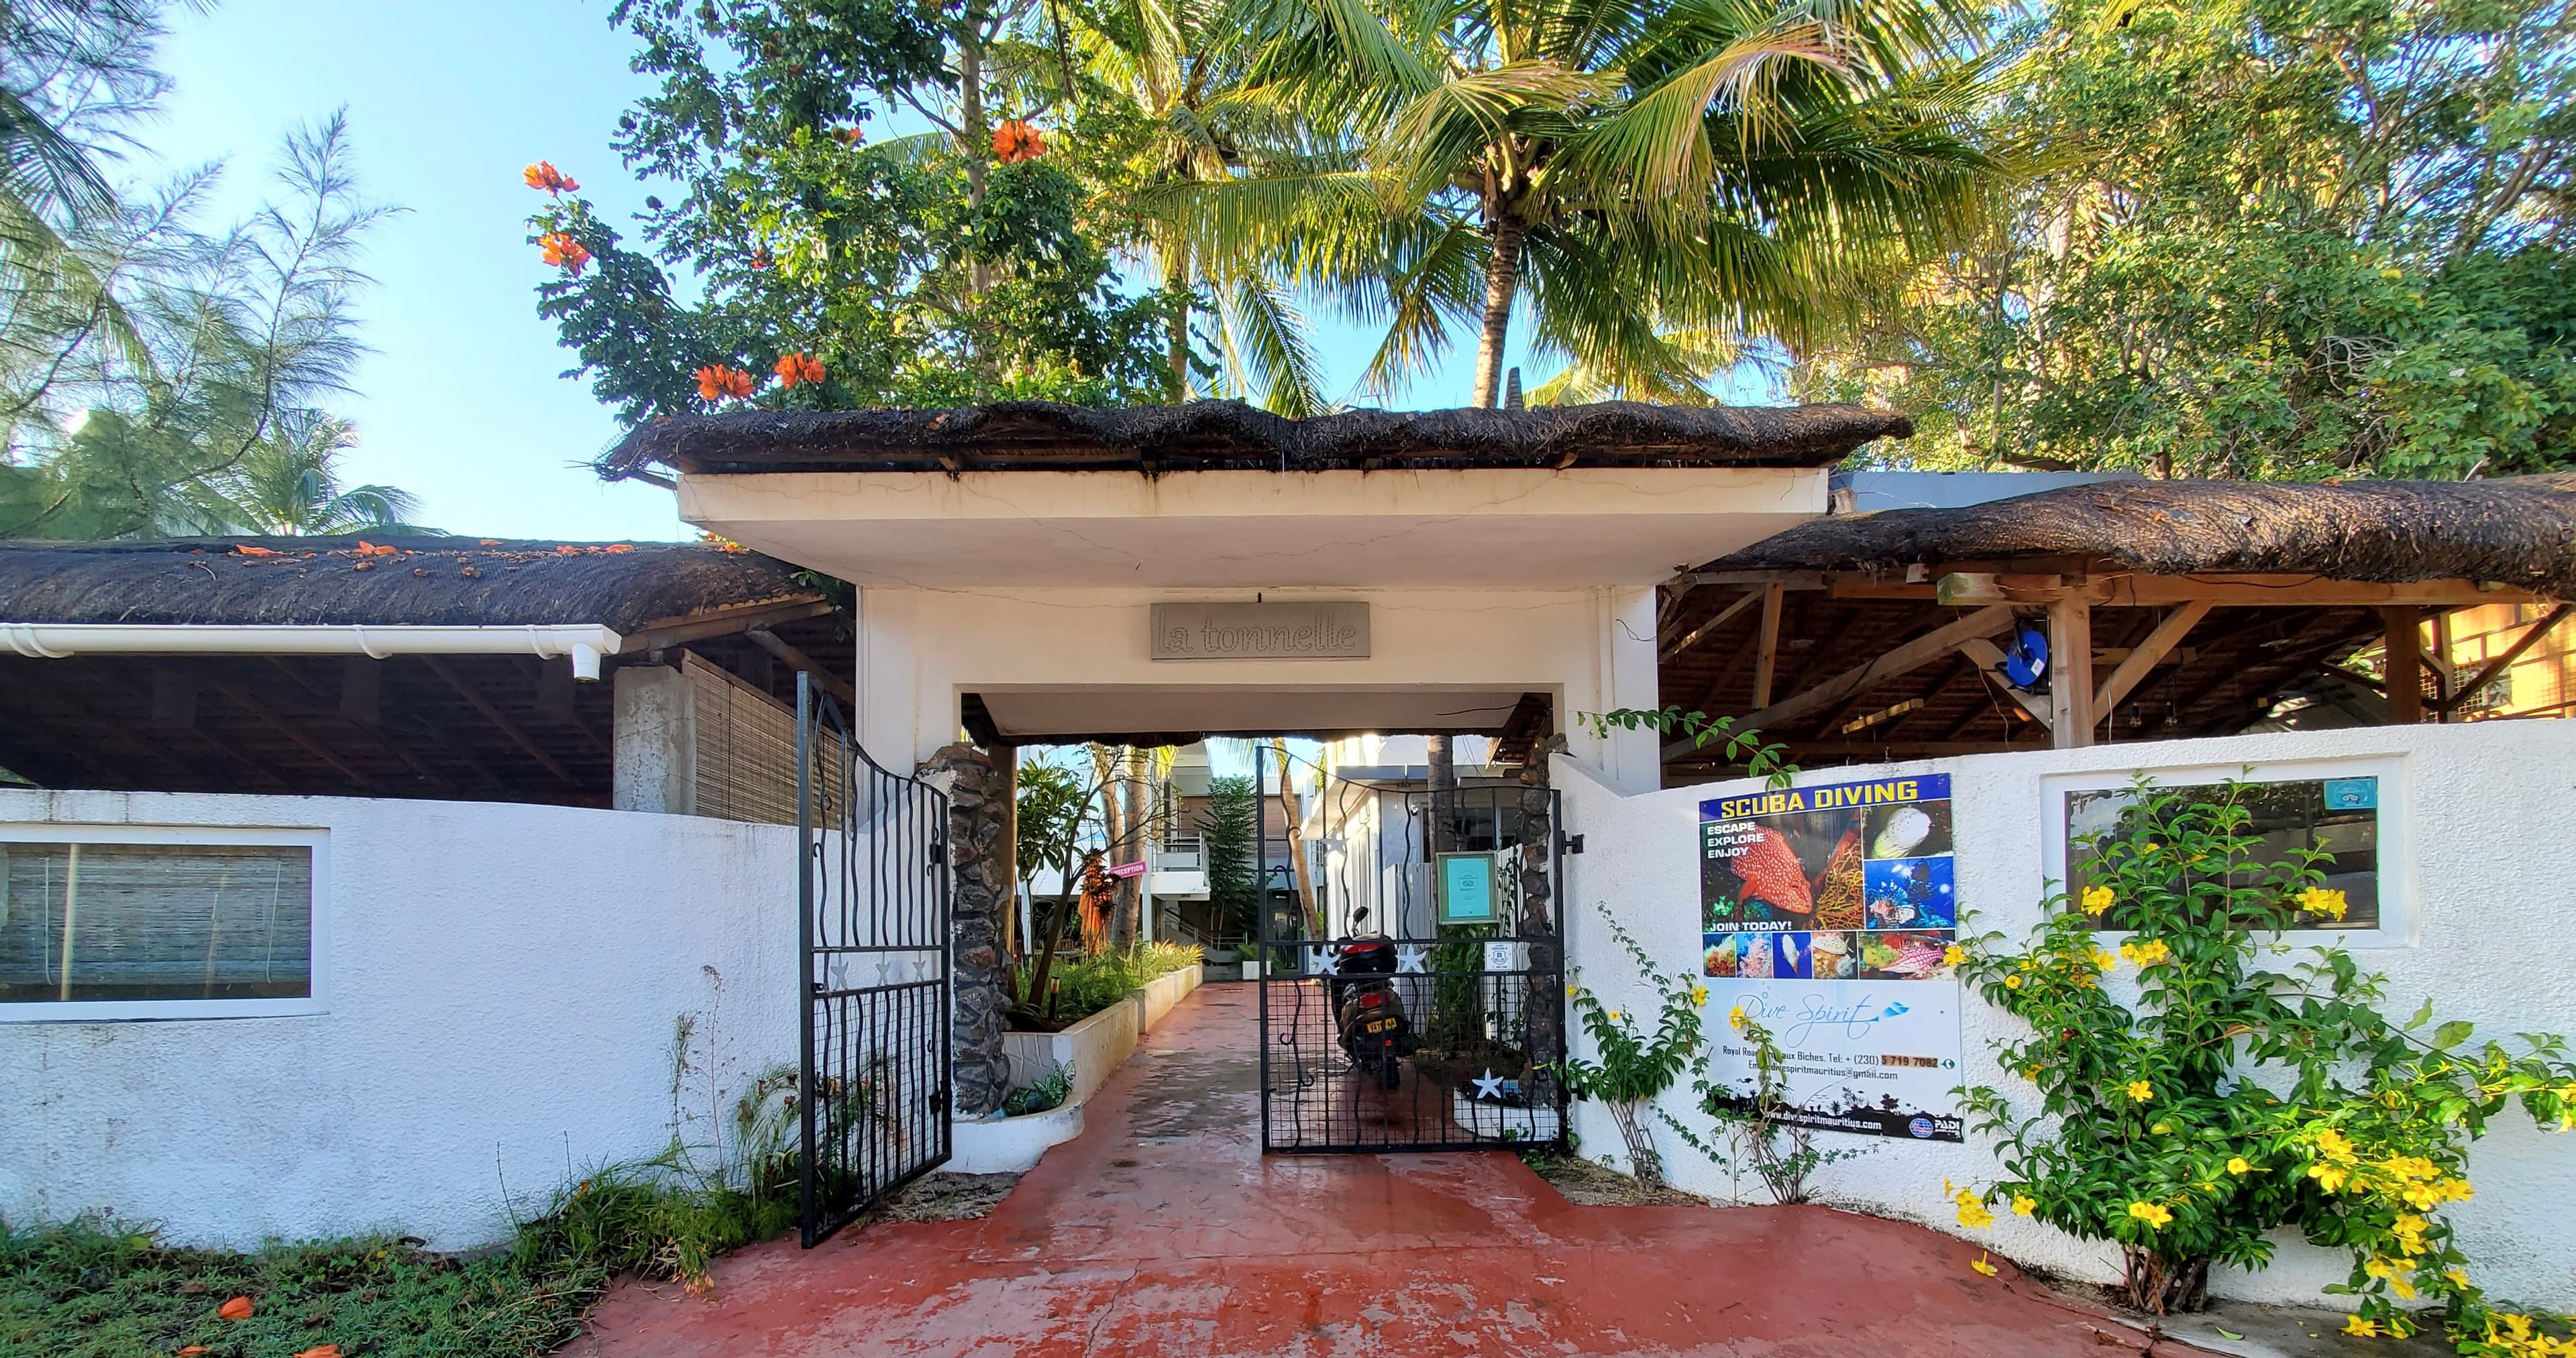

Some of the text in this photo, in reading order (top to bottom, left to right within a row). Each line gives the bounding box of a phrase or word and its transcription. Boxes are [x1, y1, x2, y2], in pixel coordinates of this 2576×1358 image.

[1158, 609, 1356, 653] la tonnelle
[1721, 780, 1919, 819] SCUBA DIVING
[1707, 822, 1756, 836] ESCAPE
[1707, 834, 1764, 847] EXPLORE
[1707, 848, 1749, 858] ENJOY
[1709, 921, 1792, 931] JOIN TODAY!
[1736, 994, 1873, 1048] Dive Spirit
[1723, 1045, 1741, 1057] Royal
[1742, 1047, 1758, 1057] Roa
[1782, 1052, 1795, 1060] aux
[1797, 1051, 1826, 1062] Biches.
[1828, 1053, 1843, 1064] Tel:
[1854, 1054, 1879, 1066] (230)
[1881, 1055, 1888, 1065] 5
[1891, 1055, 1910, 1066] 719
[1913, 1056, 1938, 1068] 7082
[1935, 1119, 1960, 1130] PADI
